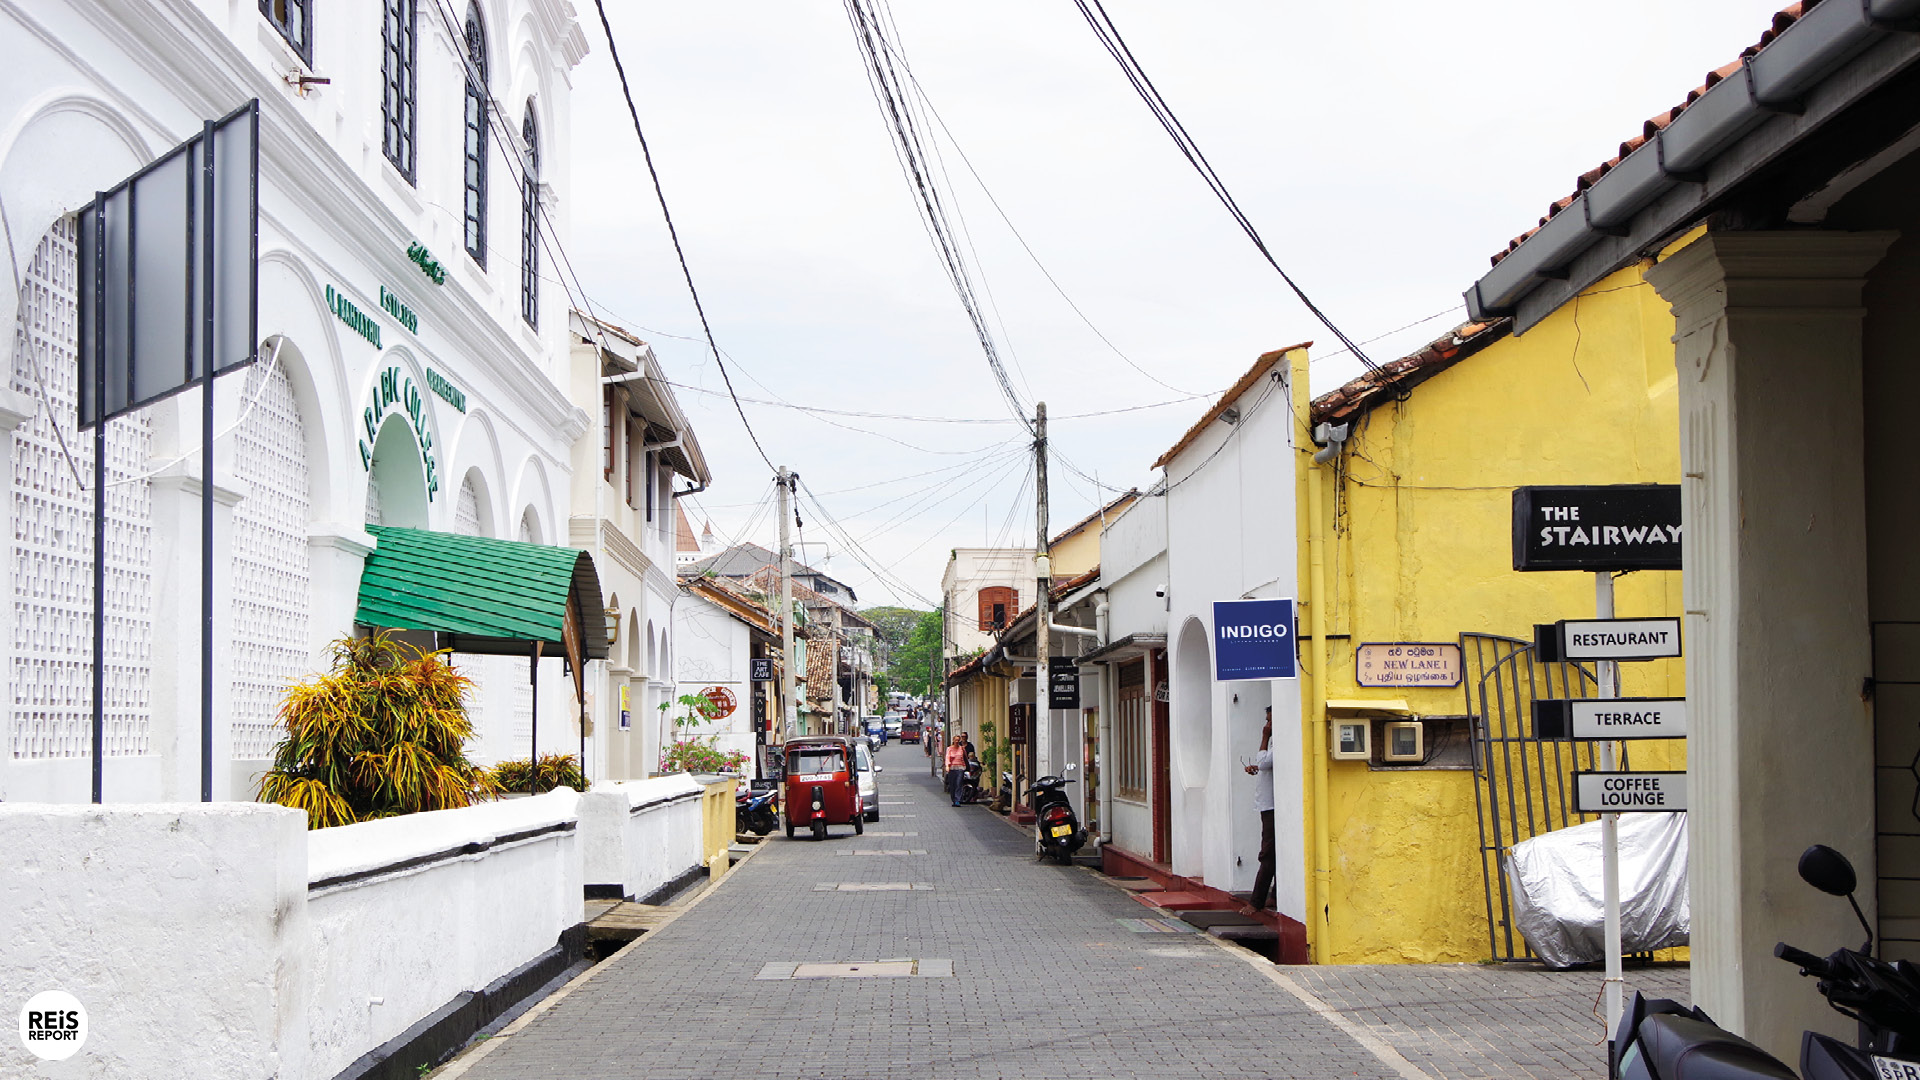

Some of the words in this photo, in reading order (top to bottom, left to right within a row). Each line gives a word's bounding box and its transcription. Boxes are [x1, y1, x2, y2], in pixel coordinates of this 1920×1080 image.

[1541, 507, 1580, 520] THE
[1540, 525, 1683, 546] STAIRWAY
[1221, 624, 1287, 639] INDIGO
[1573, 632, 1668, 646] RESTAURANT
[1384, 660, 1408, 669] NEW
[1411, 661, 1441, 669] LANE
[1595, 712, 1661, 725] TERRACE
[1604, 778, 1660, 791] COFFEE
[1602, 792, 1664, 805] LOUNGE
